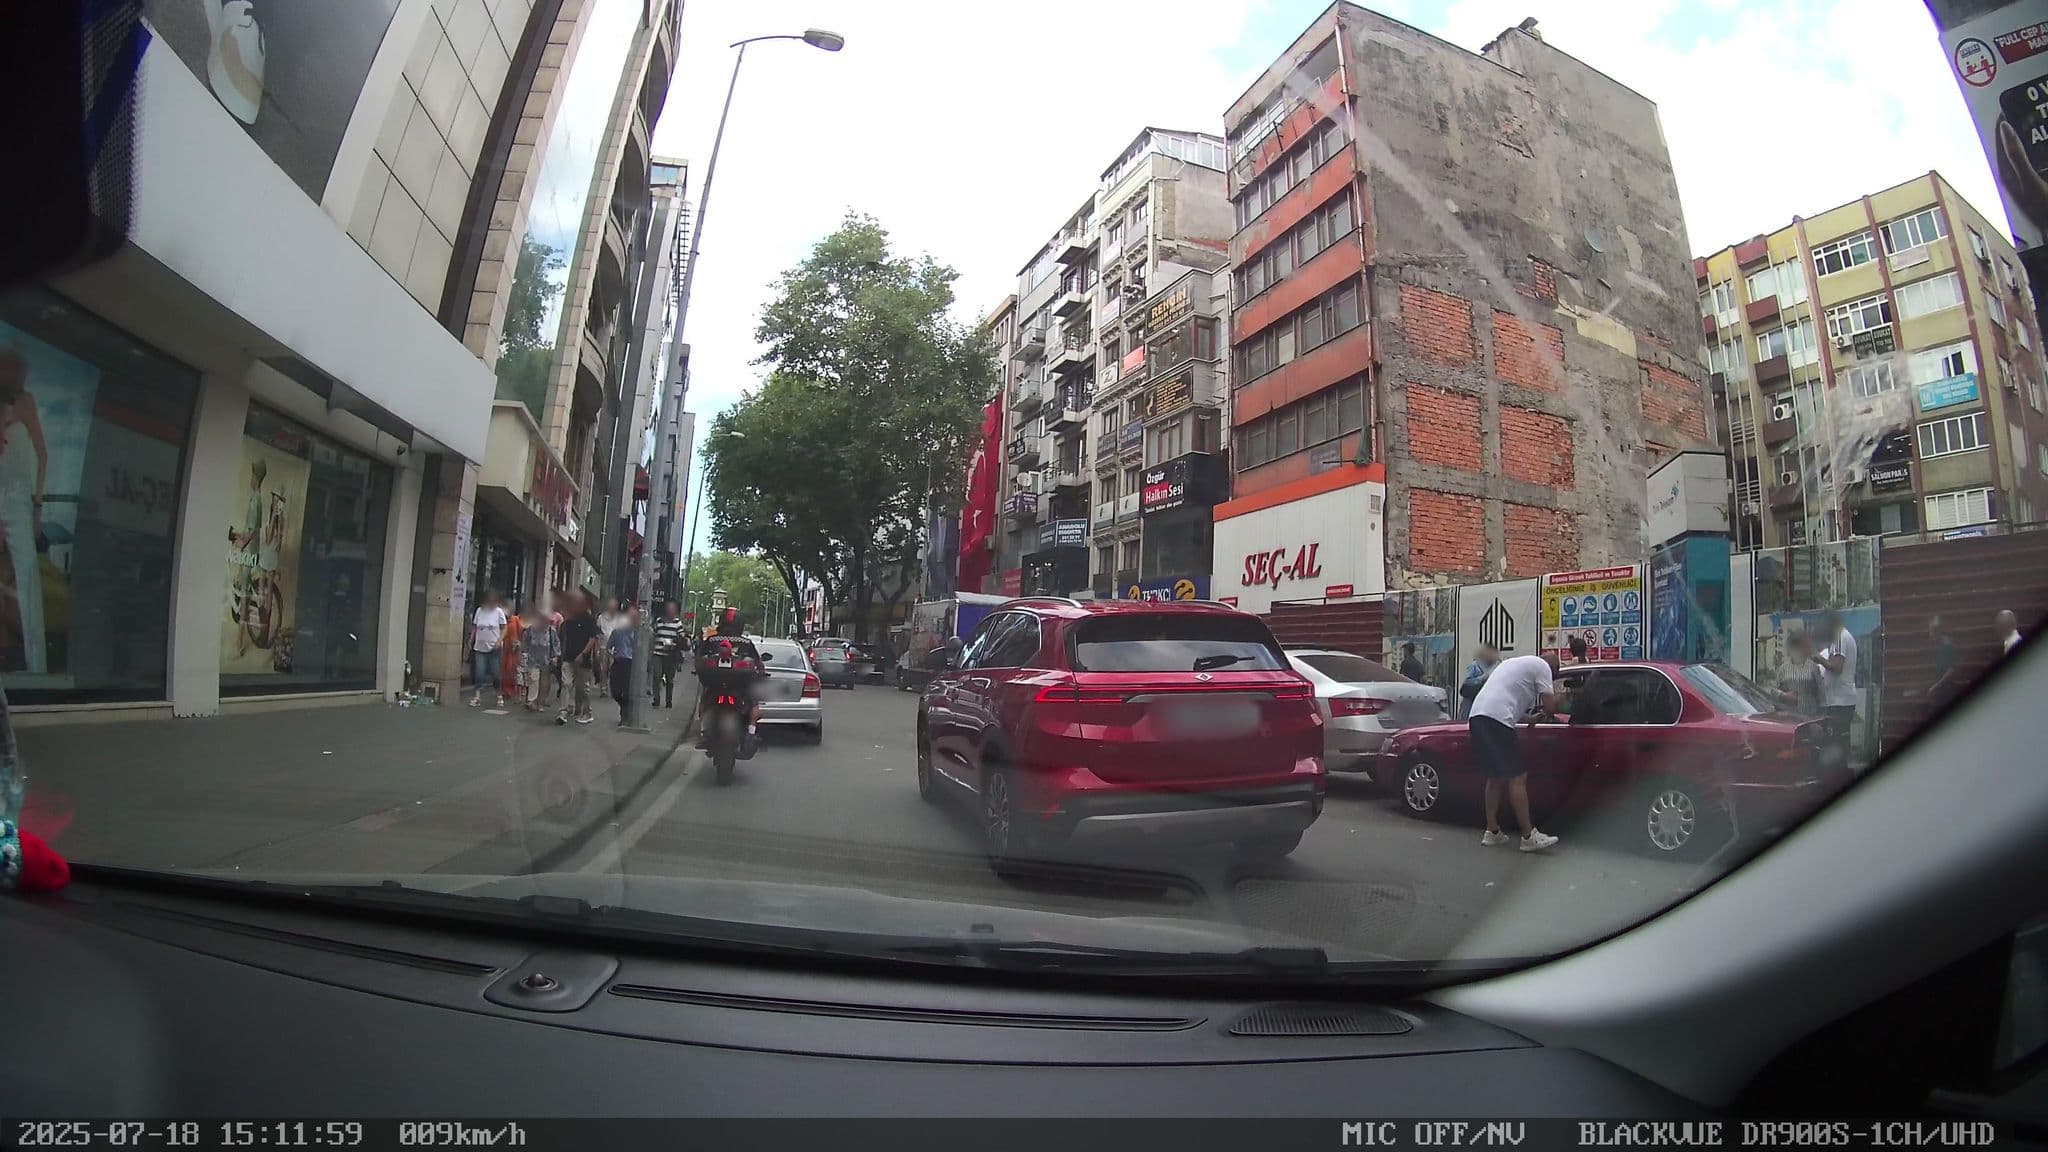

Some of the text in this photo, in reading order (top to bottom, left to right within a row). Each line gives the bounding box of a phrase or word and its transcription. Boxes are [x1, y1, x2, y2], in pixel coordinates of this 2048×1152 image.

[2020, 27, 2038, 40] CEP
[1146, 471, 1165, 484] Özgür
[1168, 482, 1184, 497] Sesi
[1241, 543, 1322, 590] SEÇ-AL
